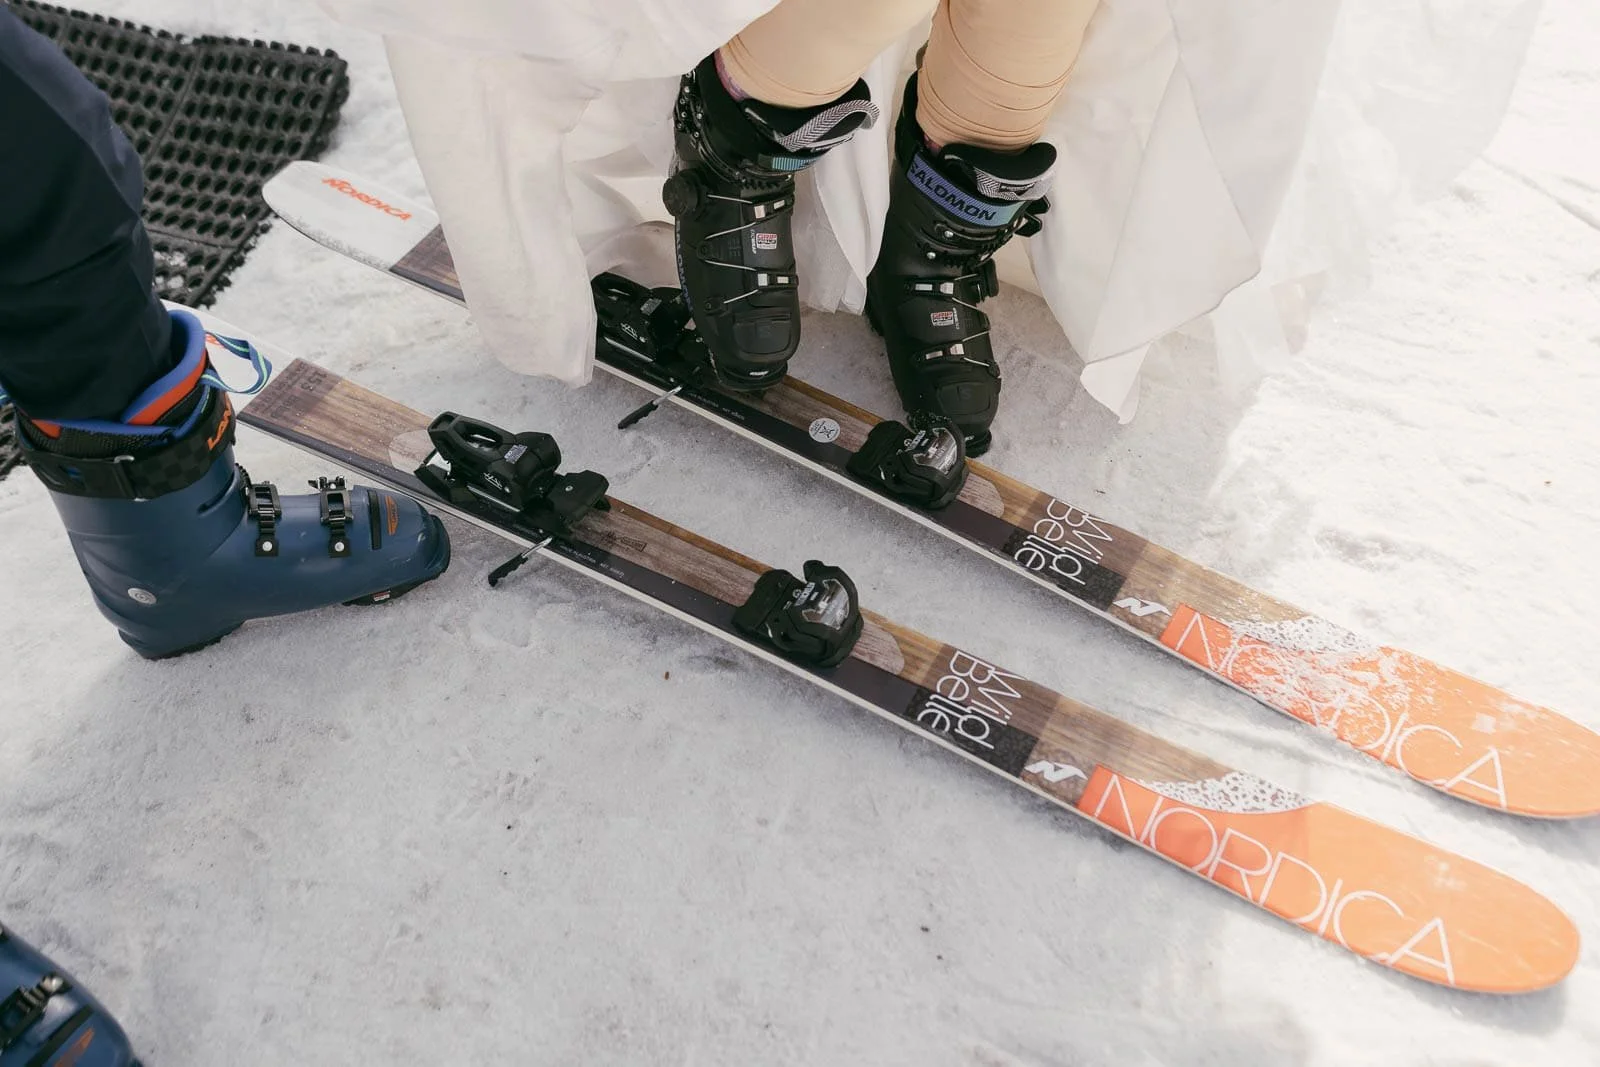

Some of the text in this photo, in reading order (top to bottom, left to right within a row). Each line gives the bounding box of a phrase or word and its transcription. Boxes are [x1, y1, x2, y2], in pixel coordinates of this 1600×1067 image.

[321, 177, 412, 220] NORDICA
[910, 162, 997, 221] SALOMON
[1014, 498, 1090, 571] Belle
[1049, 514, 1113, 585] Wild
[916, 650, 996, 733] Belle
[955, 669, 1028, 750] Wild
[1093, 774, 1455, 986] NORDICA
